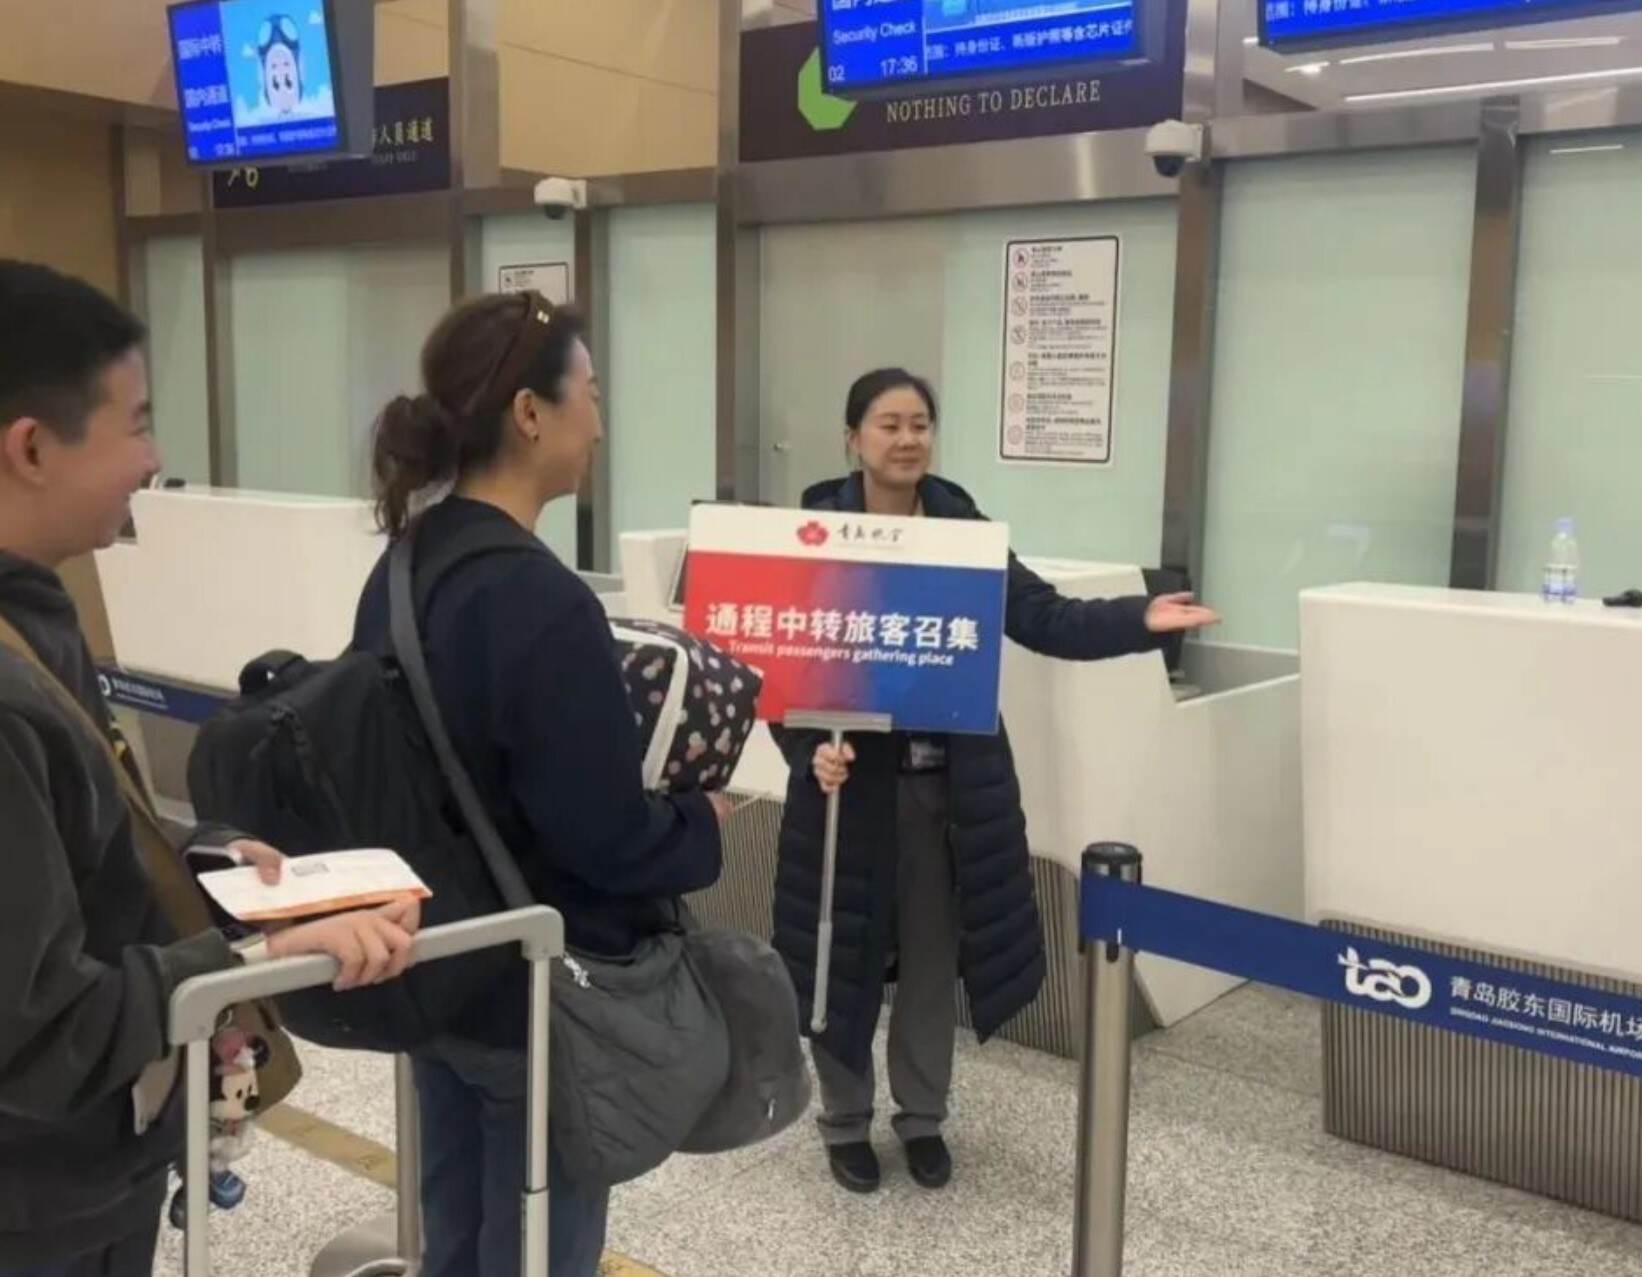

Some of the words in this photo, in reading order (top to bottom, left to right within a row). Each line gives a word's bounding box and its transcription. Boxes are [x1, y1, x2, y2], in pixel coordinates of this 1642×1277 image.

[833, 25, 878, 45] Security
[880, 19, 916, 37] Check
[828, 65, 845, 81] 02
[881, 55, 918, 76] 17:36
[887, 95, 971, 122] NOTHING
[978, 91, 1002, 114] TO
[1010, 80, 1101, 110] DECLARE
[706, 602, 979, 650] 通程中转旅客召集
[728, 639, 774, 656] Transit
[776, 643, 851, 662] passengers
[853, 647, 916, 667] gathering
[918, 649, 955, 667] place
[1450, 976, 1642, 1042] 青岛胶东国际机场
